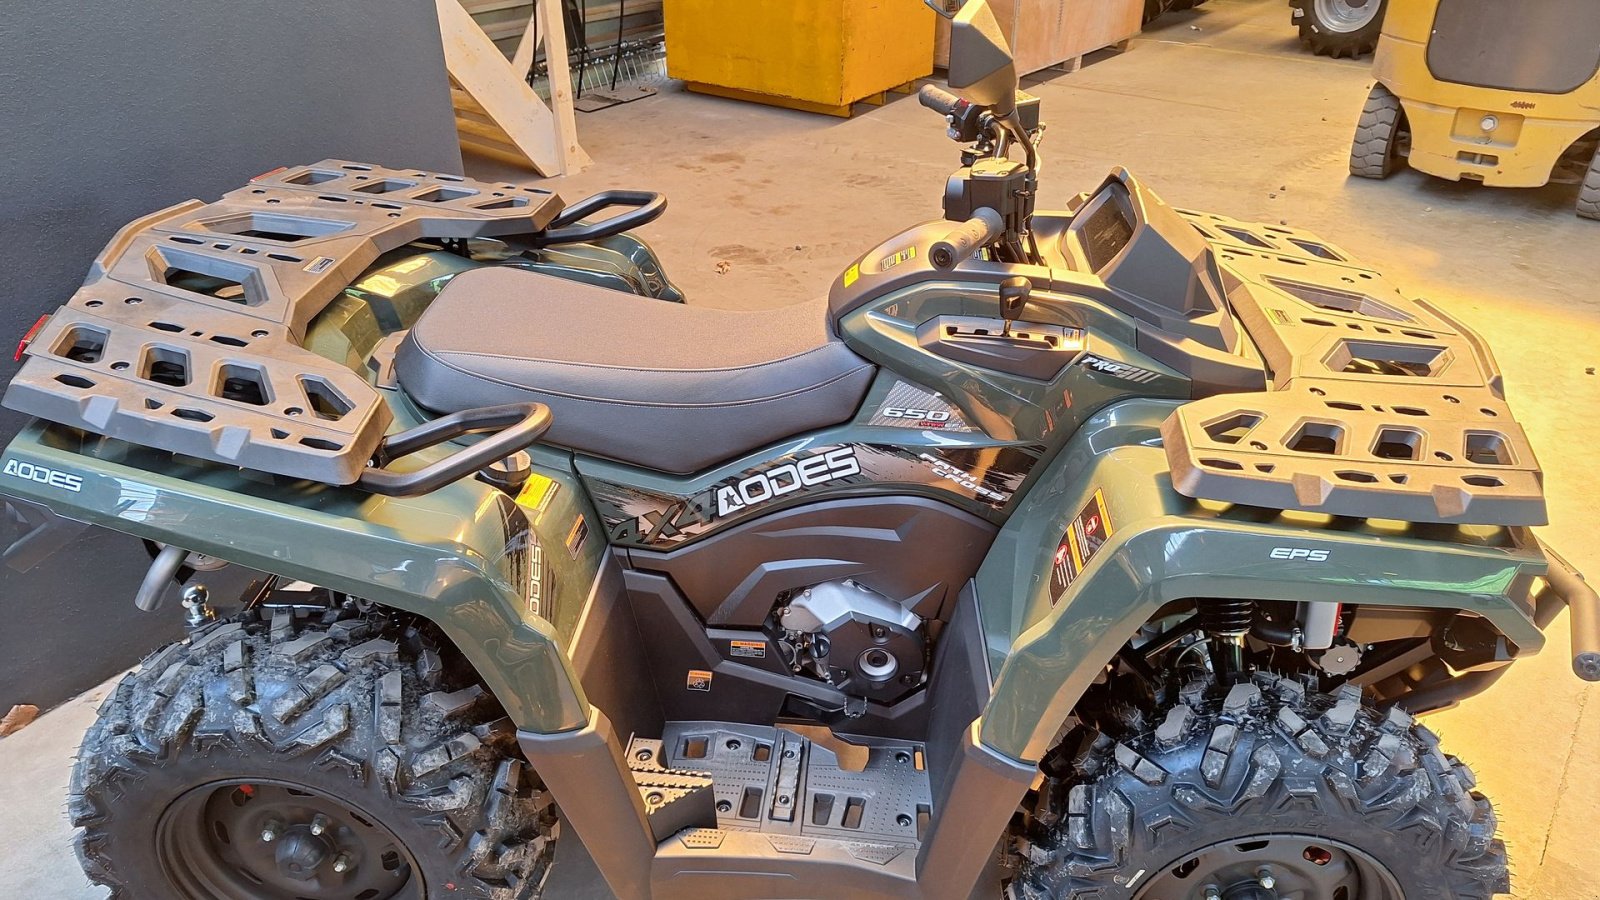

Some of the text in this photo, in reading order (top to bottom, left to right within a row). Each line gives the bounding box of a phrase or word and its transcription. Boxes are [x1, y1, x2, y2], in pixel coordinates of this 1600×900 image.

[1081, 356, 1122, 373] PRO
[883, 407, 950, 421] 650
[3, 459, 83, 492] AODES
[920, 453, 977, 481] PATH
[608, 489, 716, 543] 4X4
[717, 447, 861, 517] AODES
[932, 467, 1006, 501] CROSS
[1269, 547, 1331, 562] EPS
[529, 544, 542, 616] ODES
